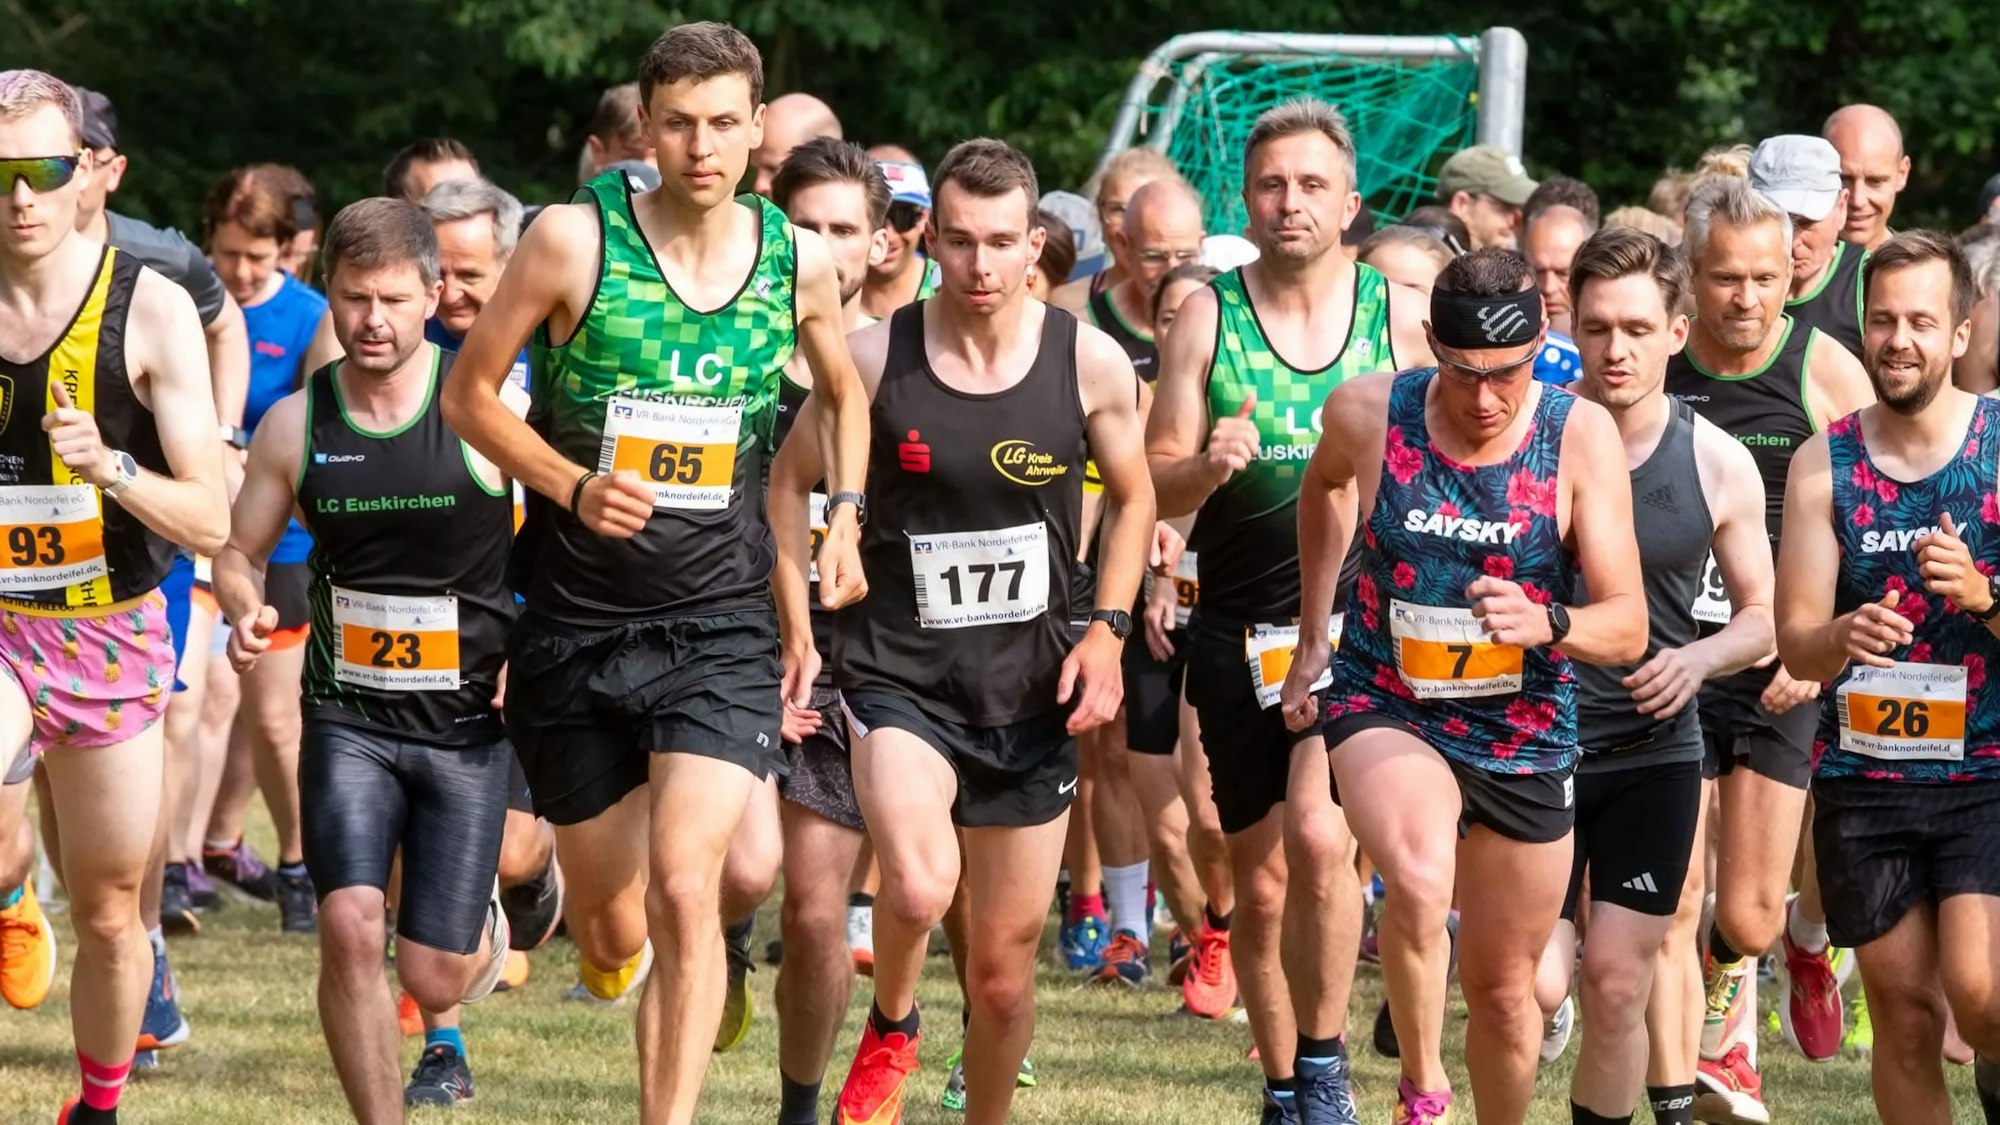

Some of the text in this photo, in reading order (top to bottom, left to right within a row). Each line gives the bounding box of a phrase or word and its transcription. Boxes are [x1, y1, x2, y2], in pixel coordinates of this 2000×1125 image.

[671, 349, 724, 386] LC
[636, 410, 675, 423] VR-Bank
[649, 443, 704, 485] 65
[1002, 447, 1053, 465] LG Kreis
[1250, 444, 1315, 461] USKI
[1025, 464, 1068, 476] Ahrweiler
[317, 494, 456, 513] LC Euskirchen
[1404, 509, 1523, 544] SAYSKY
[8, 526, 65, 567] 93
[935, 539, 976, 551] VR-Bank
[978, 535, 1022, 547] Nordeifel
[940, 560, 1025, 605] 177
[371, 631, 421, 669] 23
[1447, 645, 1473, 679] 7
[342, 669, 451, 684] www.vr-banknordeifel.de
[1899, 671, 1941, 682] Nordeifel
[1876, 699, 1929, 738] 26
